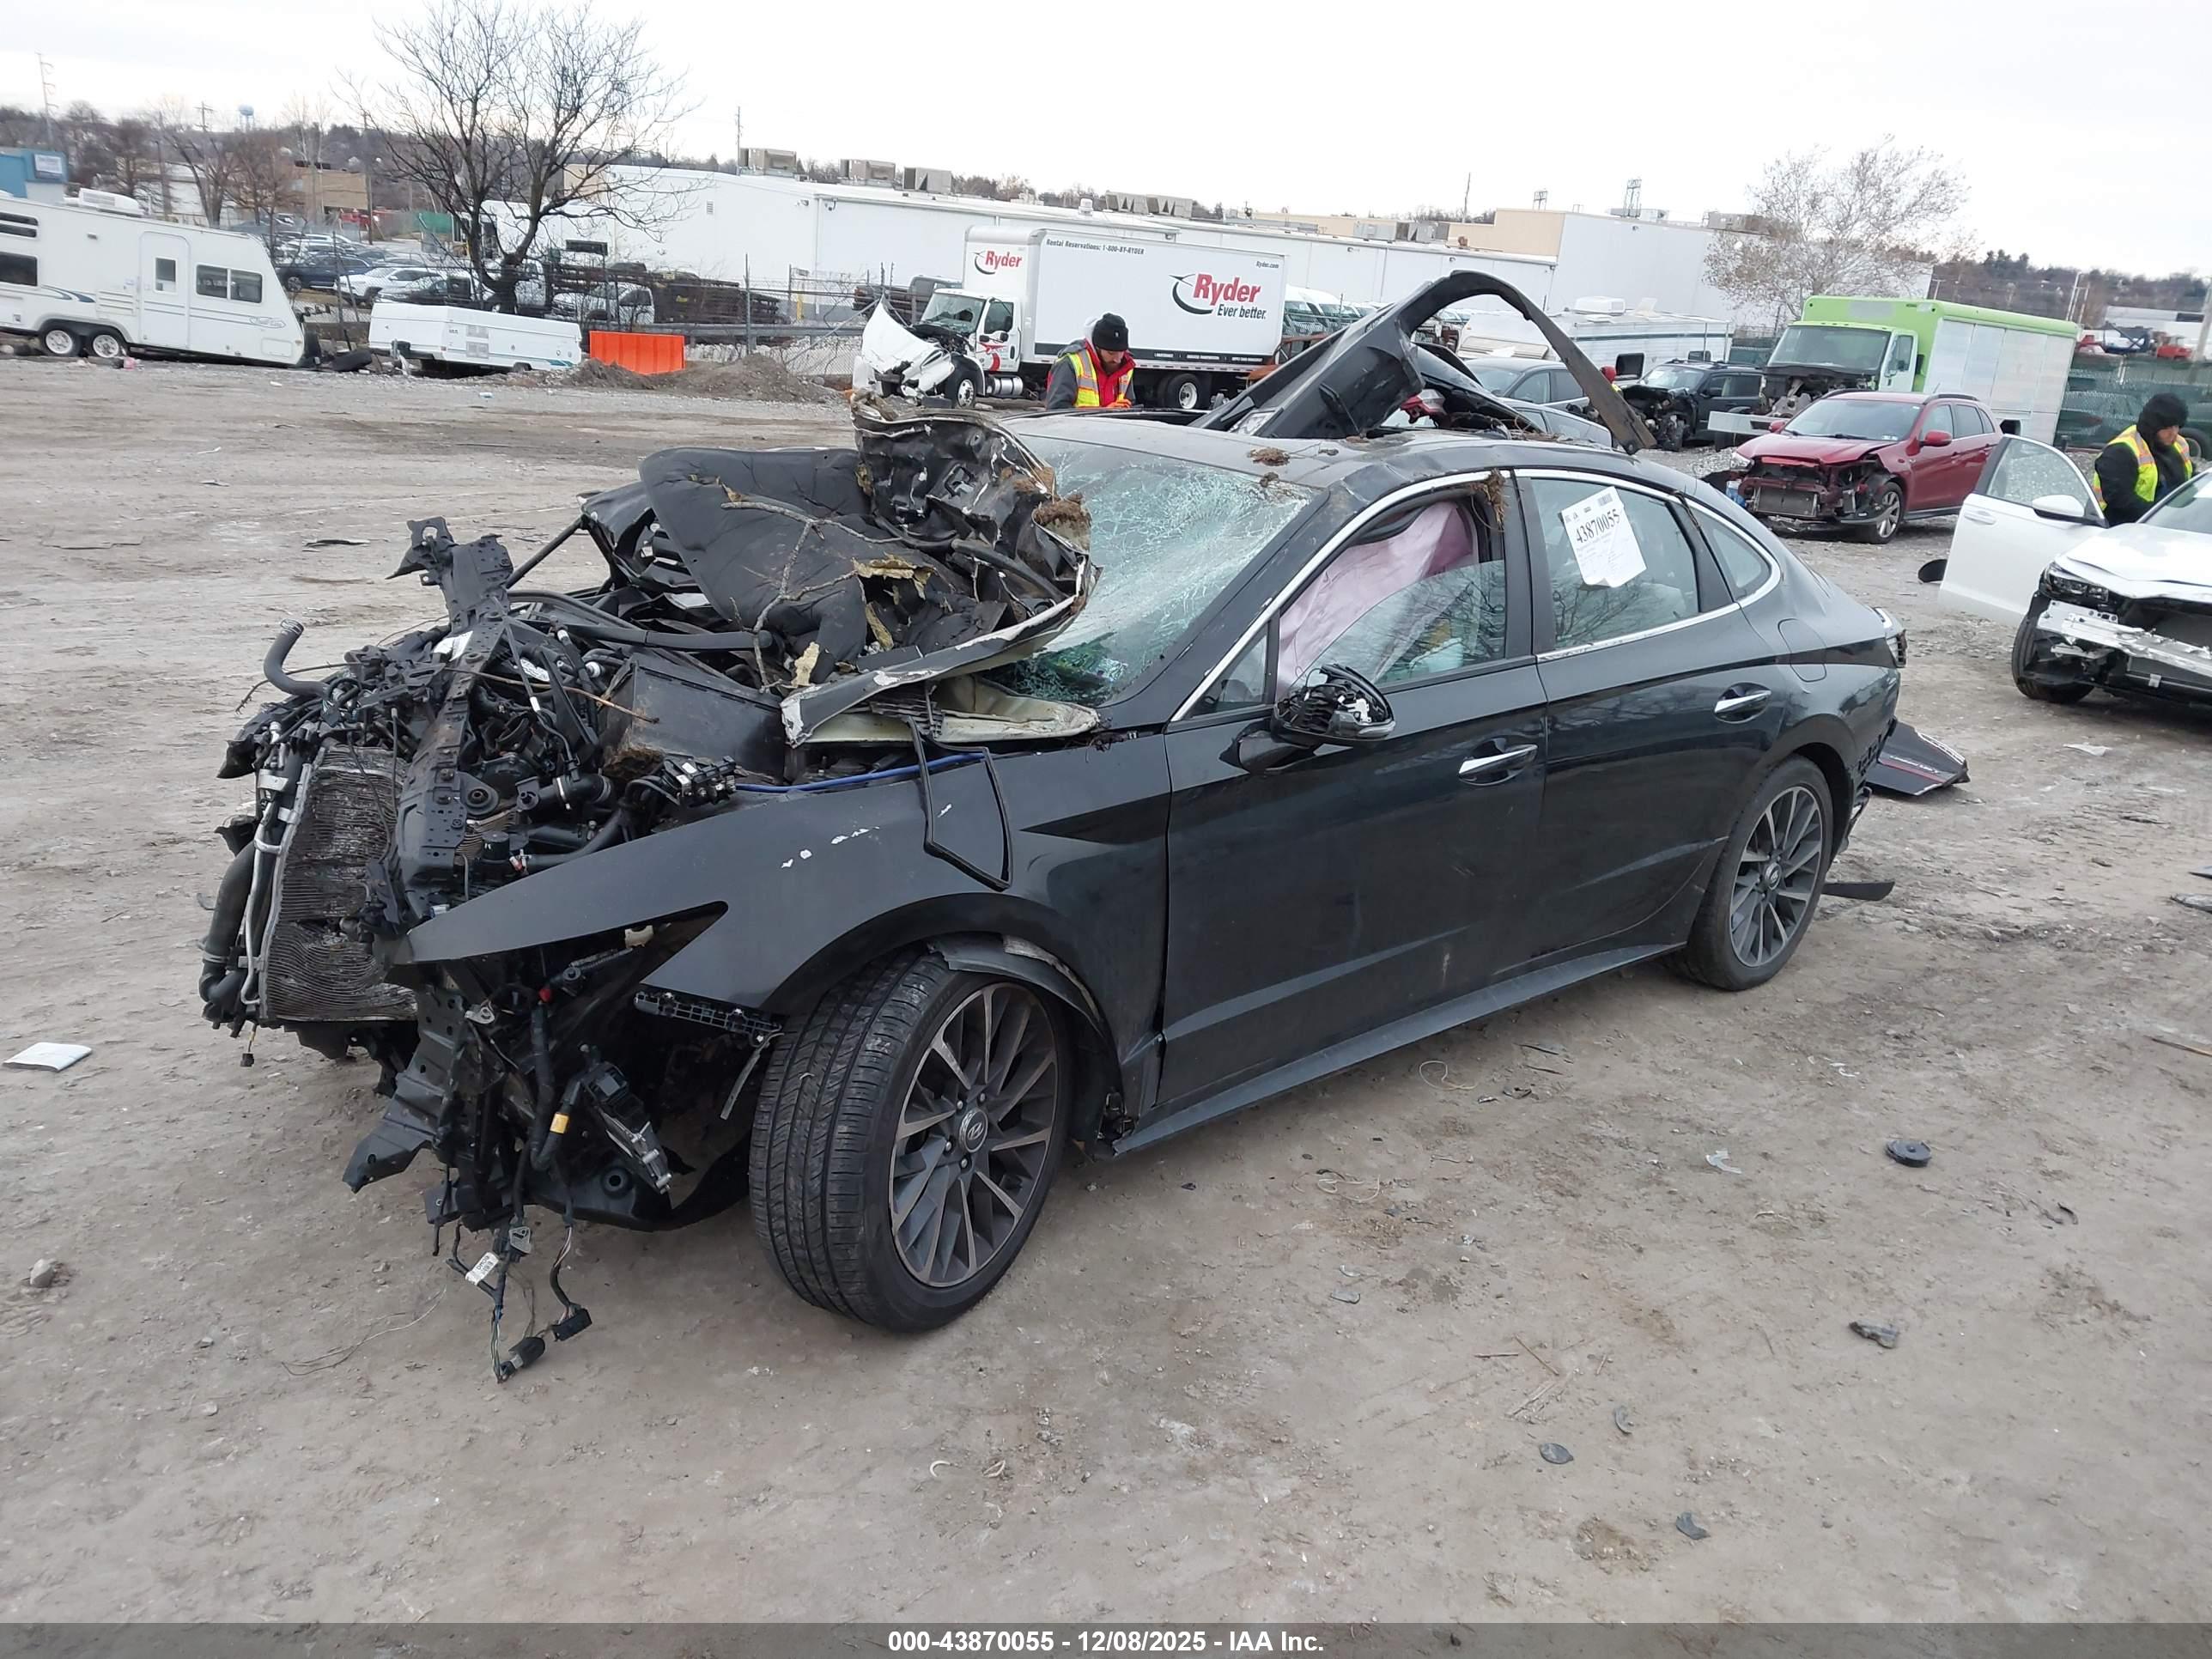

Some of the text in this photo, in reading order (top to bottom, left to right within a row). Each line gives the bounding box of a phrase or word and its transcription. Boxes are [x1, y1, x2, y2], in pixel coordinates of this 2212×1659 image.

[1046, 239, 1064, 247] Rental
[1065, 240, 1101, 251] Reservations:
[985, 250, 1023, 270] Ryder
[1255, 260, 1279, 269] Ryder.com
[1193, 273, 1261, 307] Ryder
[1217, 303, 1239, 317] Ever
[1576, 508, 1620, 544] 43870055
